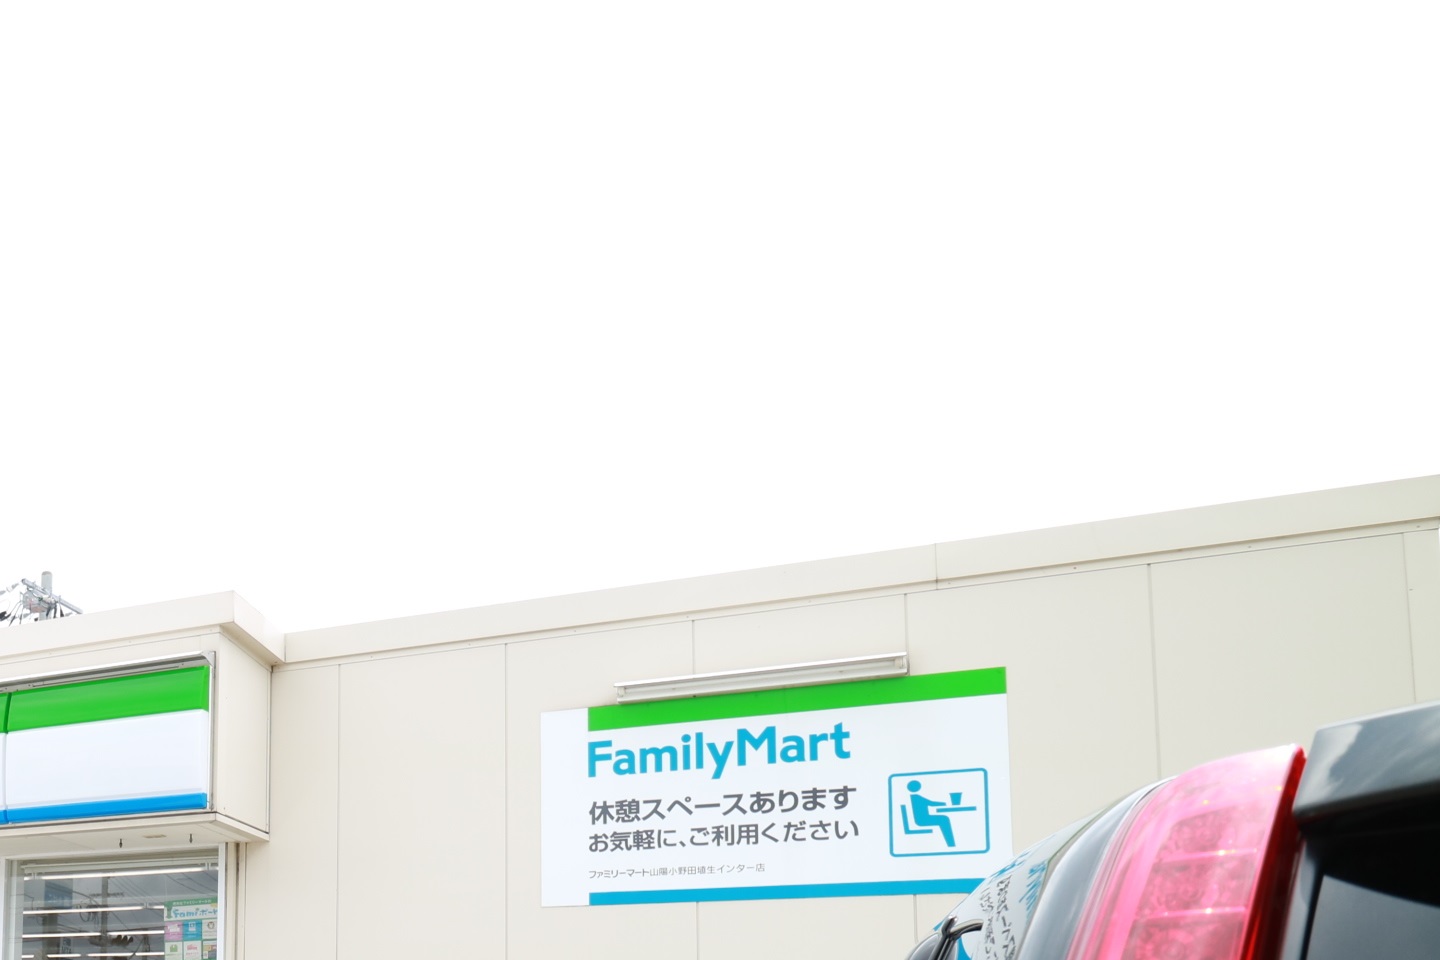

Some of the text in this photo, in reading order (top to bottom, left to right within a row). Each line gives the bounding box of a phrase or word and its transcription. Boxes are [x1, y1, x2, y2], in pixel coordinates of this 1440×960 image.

[588, 722, 851, 779] FamilyMart
[588, 785, 858, 825] 休憩スペースあります
[588, 820, 859, 853] お気軽に、ご利用ください
[588, 862, 766, 879] ファミリーマート山陽小野田埴生インター店
